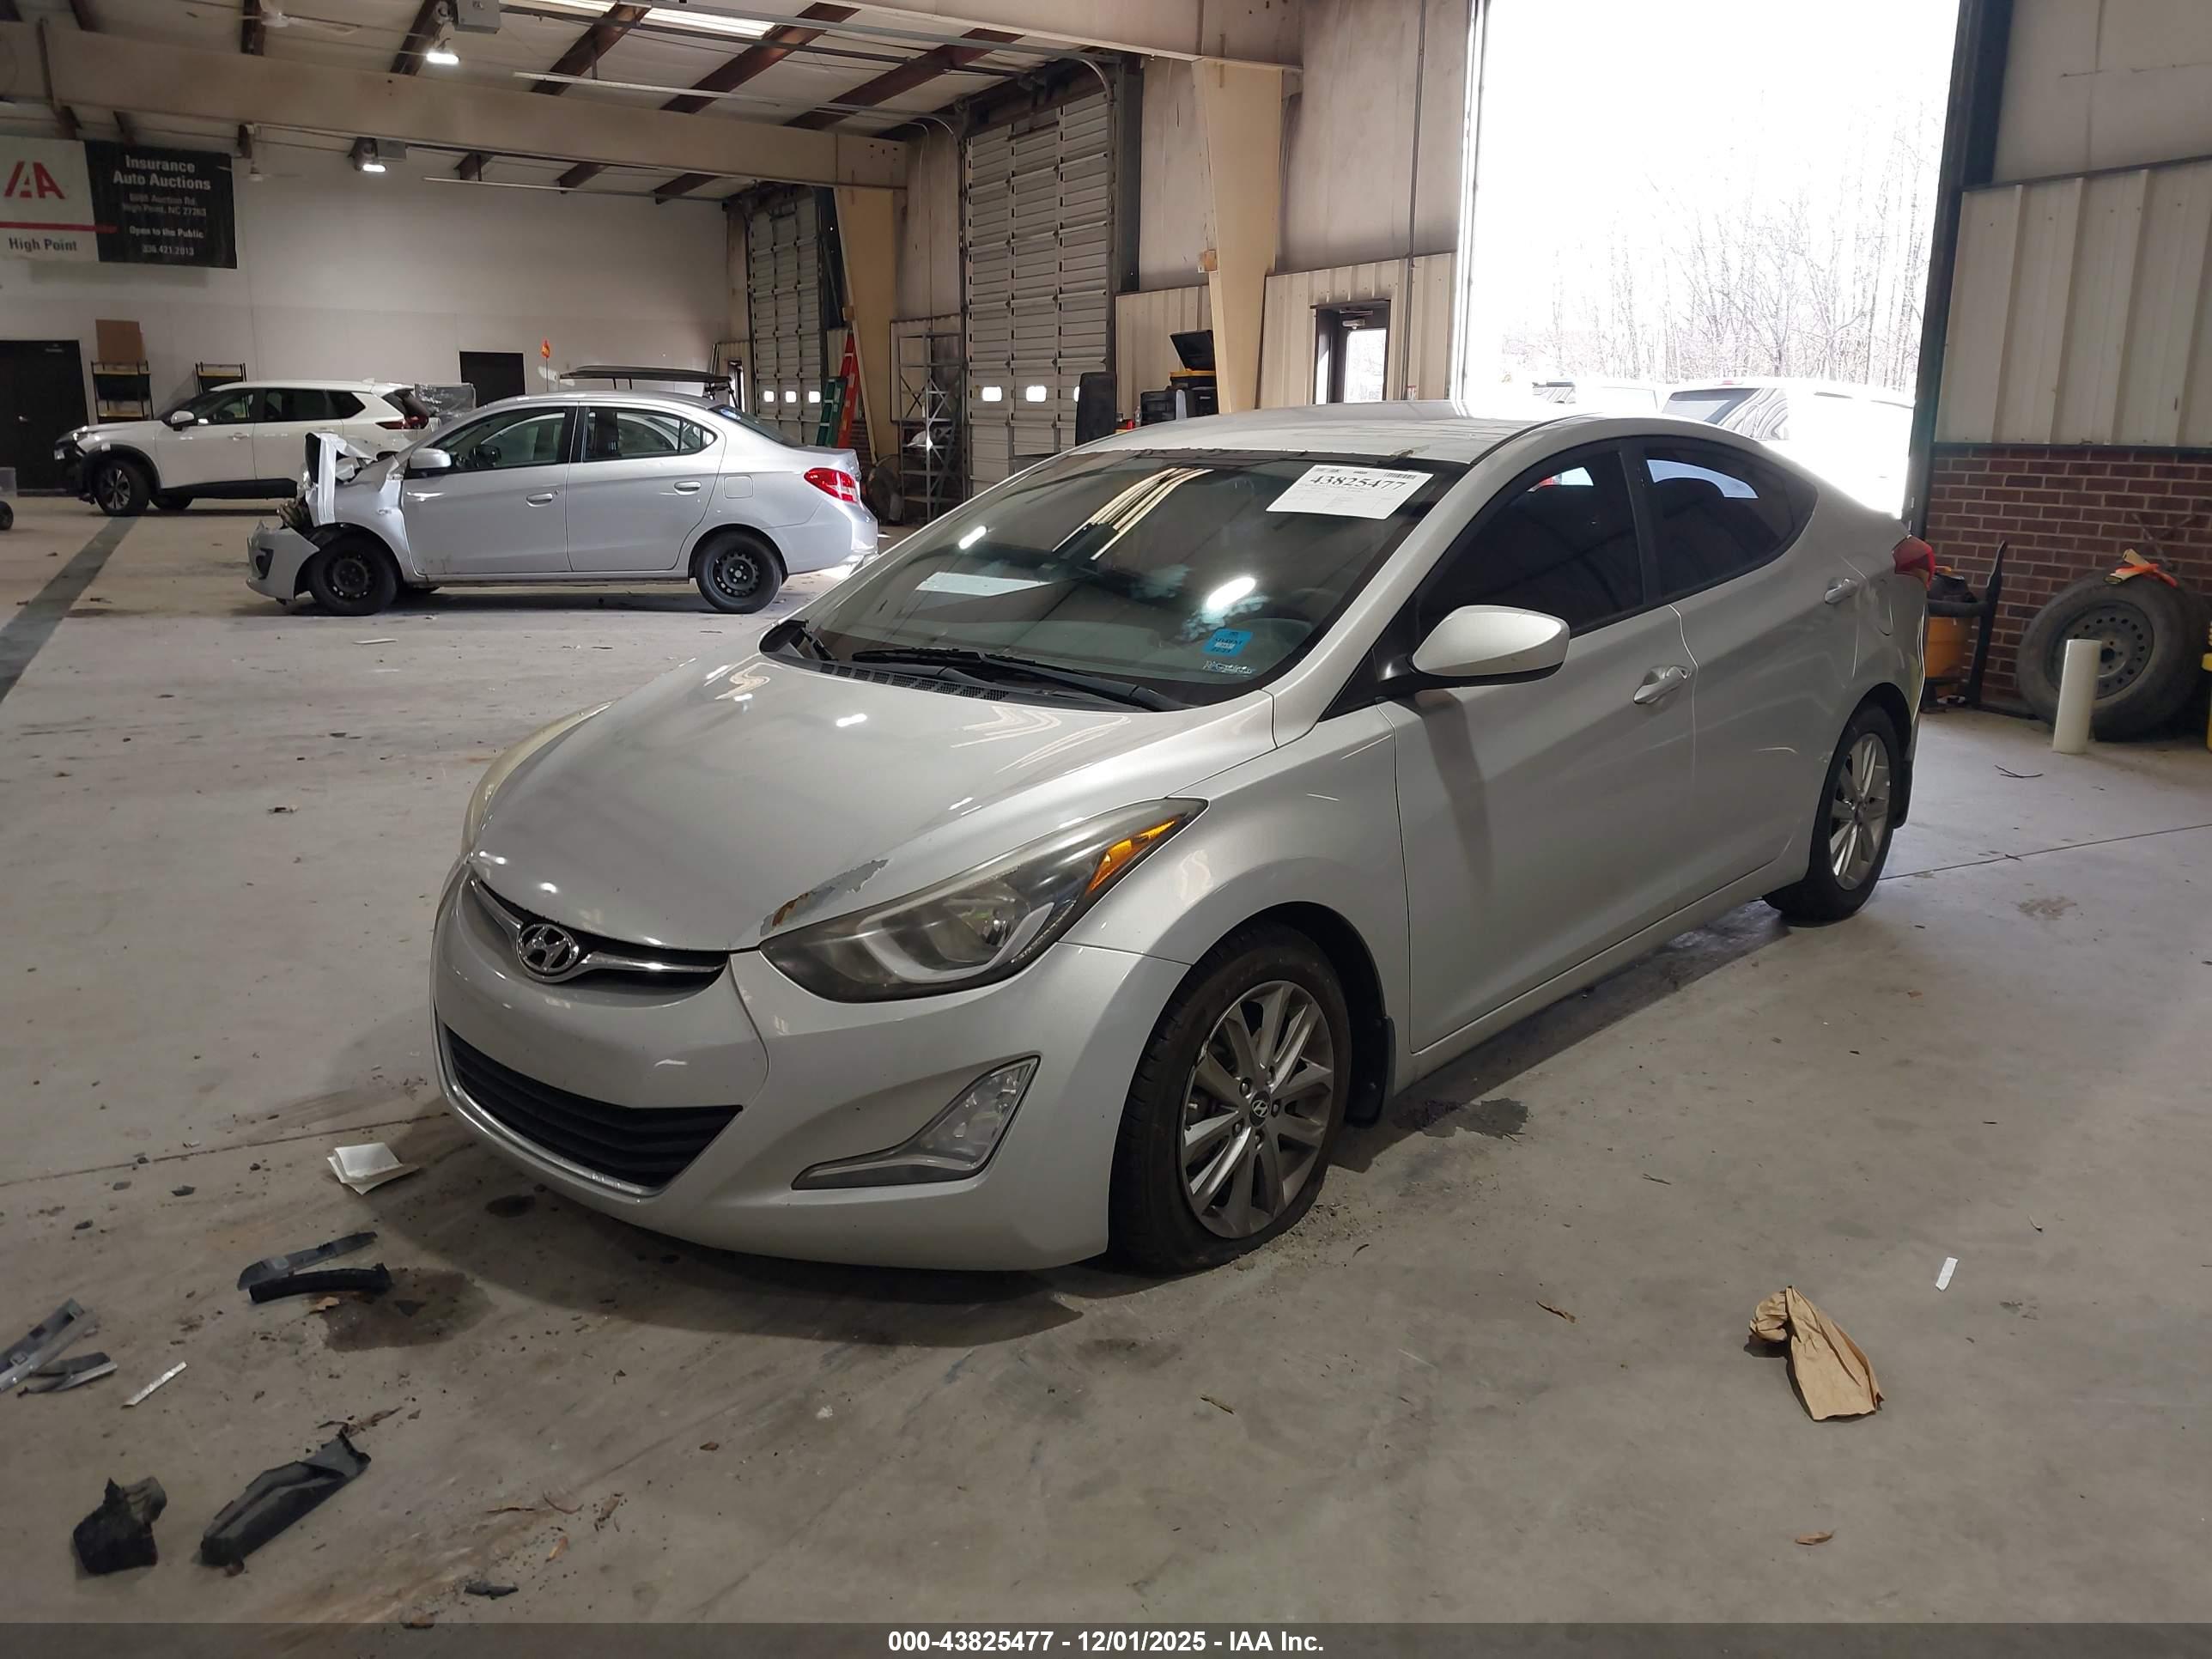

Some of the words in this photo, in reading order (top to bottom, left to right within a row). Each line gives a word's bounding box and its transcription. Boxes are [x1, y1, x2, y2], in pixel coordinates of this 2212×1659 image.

[125, 155, 196, 173] Insurance
[112, 170, 146, 186] Auto
[149, 173, 211, 191] Auctions
[129, 225, 151, 236] Open
[152, 227, 161, 236] to
[177, 228, 204, 239] Public
[9, 237, 40, 252] High
[43, 238, 77, 252] Point
[1310, 474, 1407, 490] 43825477
